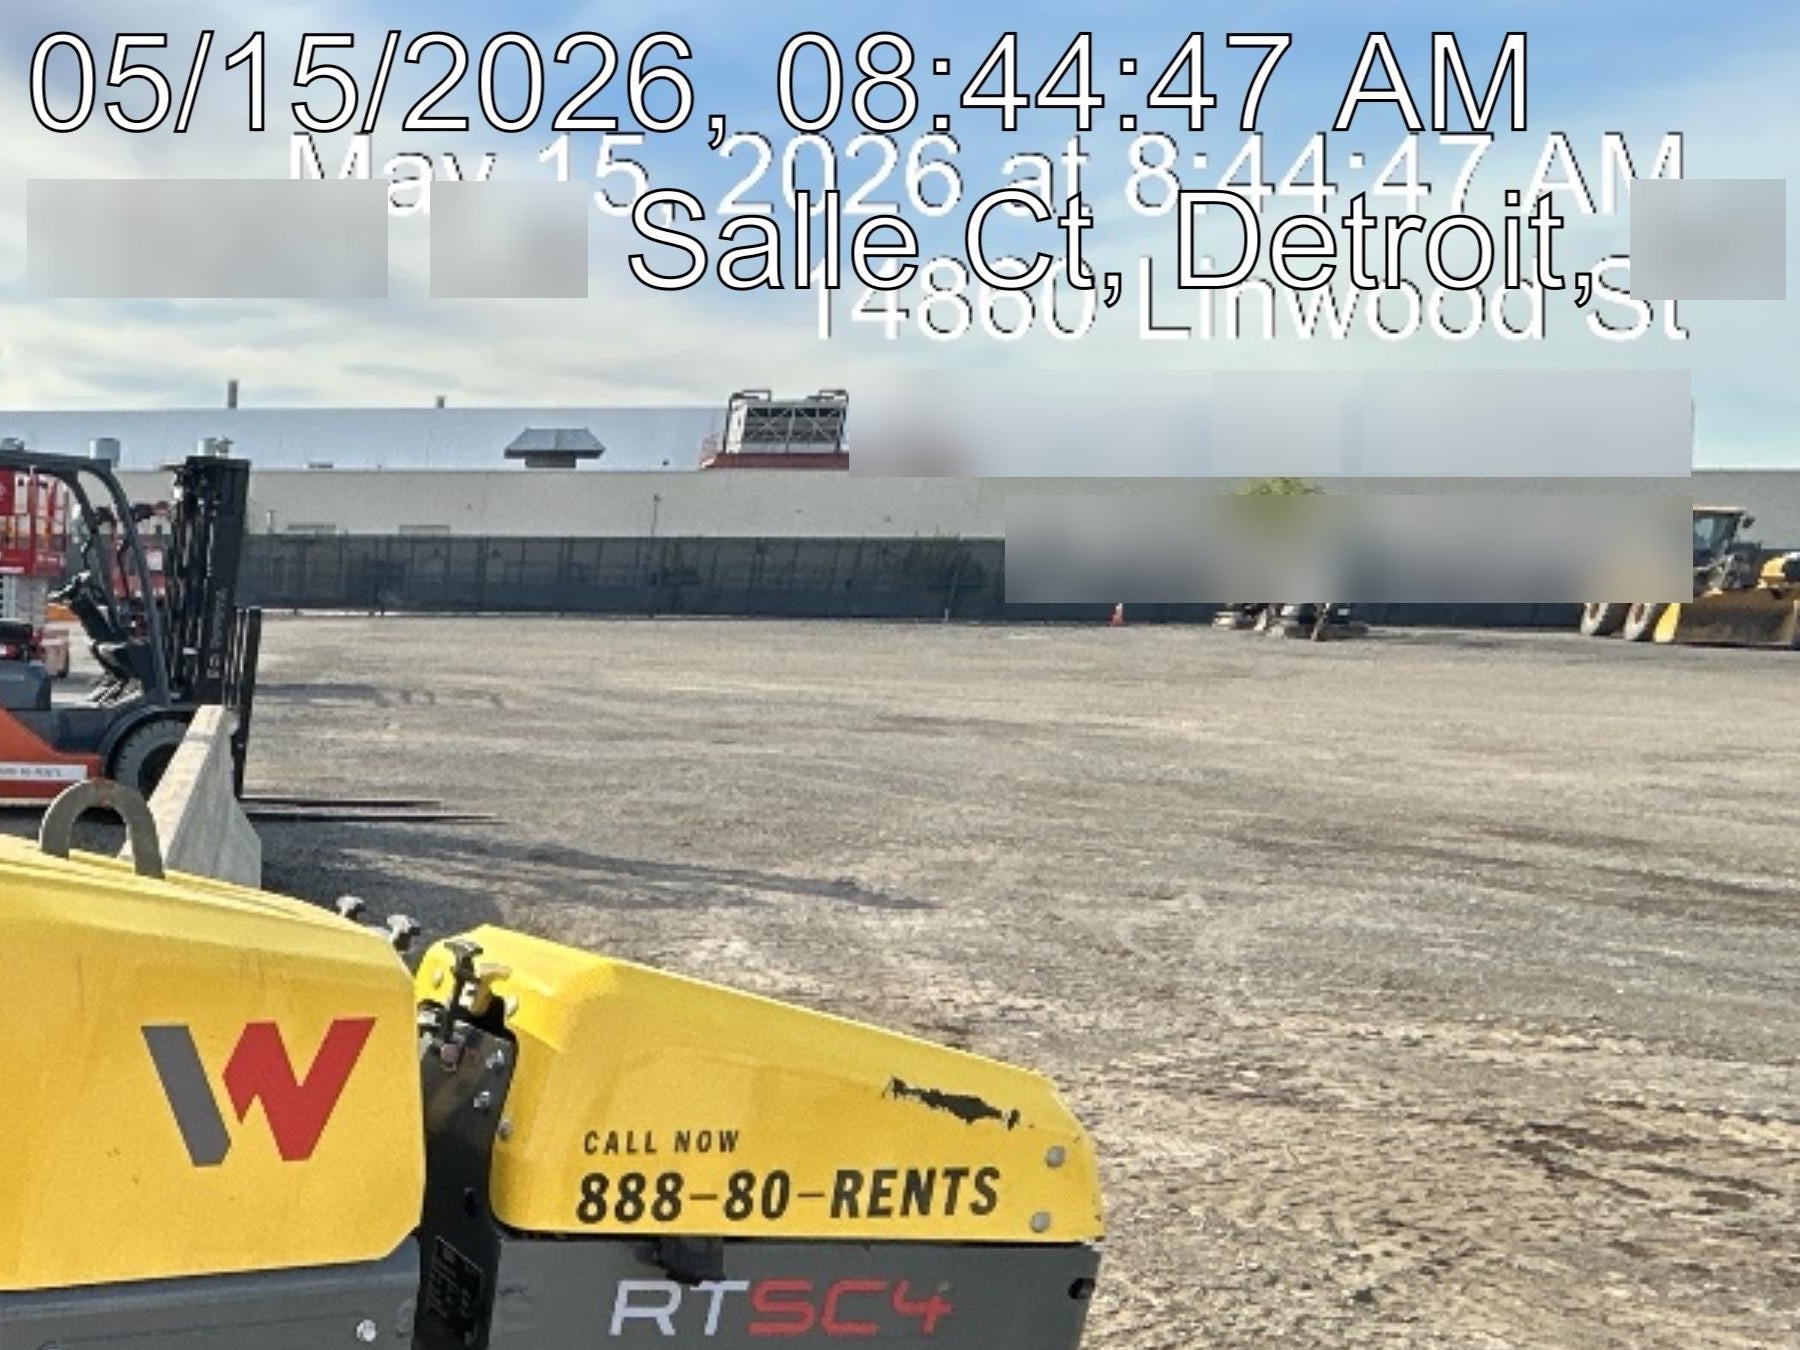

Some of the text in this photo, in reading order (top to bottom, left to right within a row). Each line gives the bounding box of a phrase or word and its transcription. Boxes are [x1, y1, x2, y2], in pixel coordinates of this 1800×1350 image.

[583, 1129, 740, 1155] CALL NOW
[576, 1166, 1000, 1224] 888-80-RENTS
